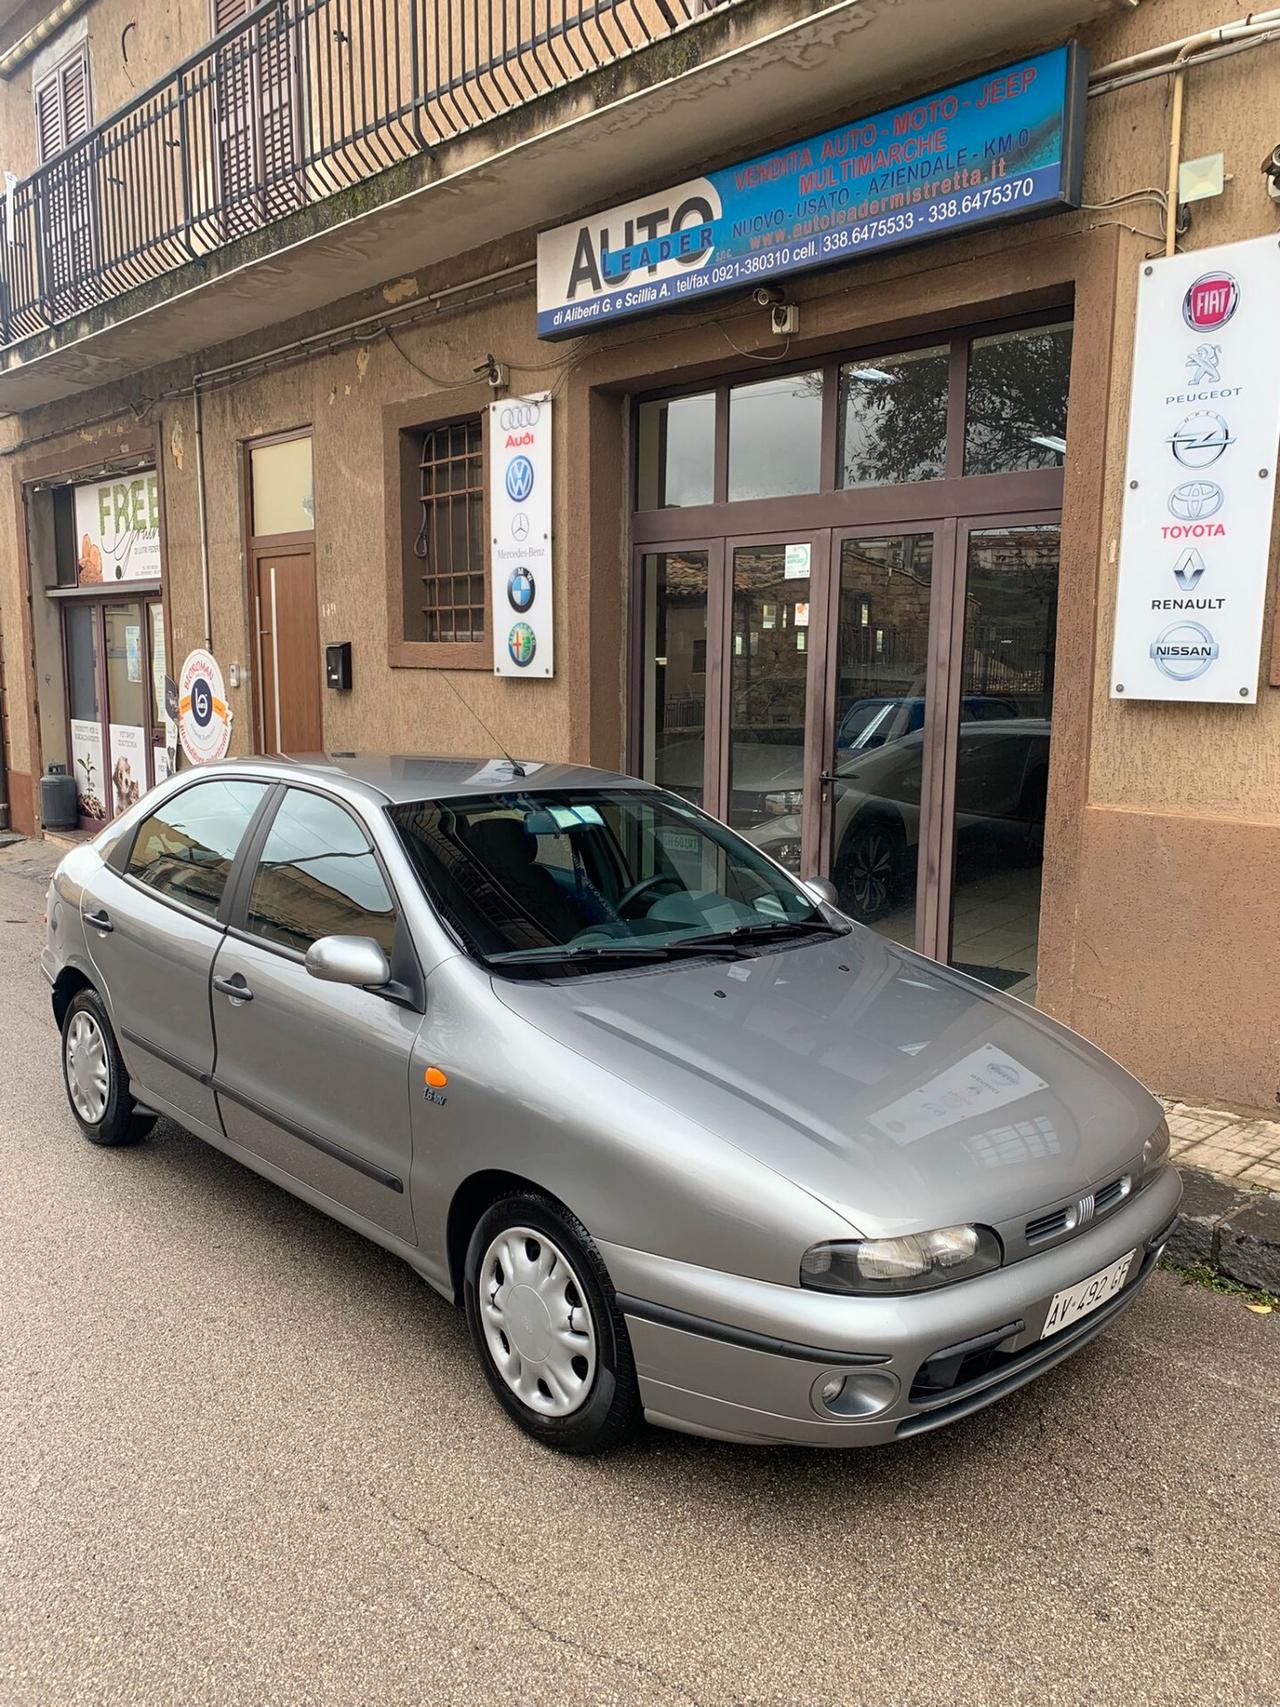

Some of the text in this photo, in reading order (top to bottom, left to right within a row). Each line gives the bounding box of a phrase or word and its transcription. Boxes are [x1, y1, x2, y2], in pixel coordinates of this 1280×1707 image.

[736, 147, 812, 191] VENDITA
[821, 122, 877, 162] AUTO
[894, 95, 958, 137] MOTO
[976, 66, 1037, 110] JEEP
[733, 208, 785, 238] NUOVO
[797, 187, 849, 218] USATO
[868, 147, 967, 195] AZIENDALE
[985, 133, 1012, 159] KM
[1018, 128, 1030, 149] 0
[800, 128, 948, 195] MULTIMARCHE
[751, 157, 1007, 250] www.autoleadermistretta.it
[553, 312, 563, 325] di
[564, 301, 600, 323] Aliberti
[602, 300, 613, 312] G.
[616, 300, 622, 309] e
[625, 286, 657, 306] Scillia
[659, 283, 671, 299] A.
[677, 273, 709, 293] tel/fax
[712, 249, 790, 284] 0921-380310
[793, 241, 818, 261] cell.
[823, 212, 914, 252] 338.6475533
[928, 177, 1034, 223] 338.6475370
[566, 196, 714, 300] AUTO
[603, 227, 714, 276] LEADER
[1195, 287, 1229, 318] FIAT
[1165, 386, 1244, 405] PEUGEOT
[505, 432, 535, 449] Audi
[98, 476, 160, 536] FREE
[497, 547, 545, 560] Mercedes-Benz
[1161, 524, 1226, 540] TOYOTA
[1151, 598, 1226, 611] RENAULT
[1155, 645, 1212, 657] NISSAN
[1046, 1295, 1073, 1329] AV
[1076, 1275, 1108, 1311] 492
